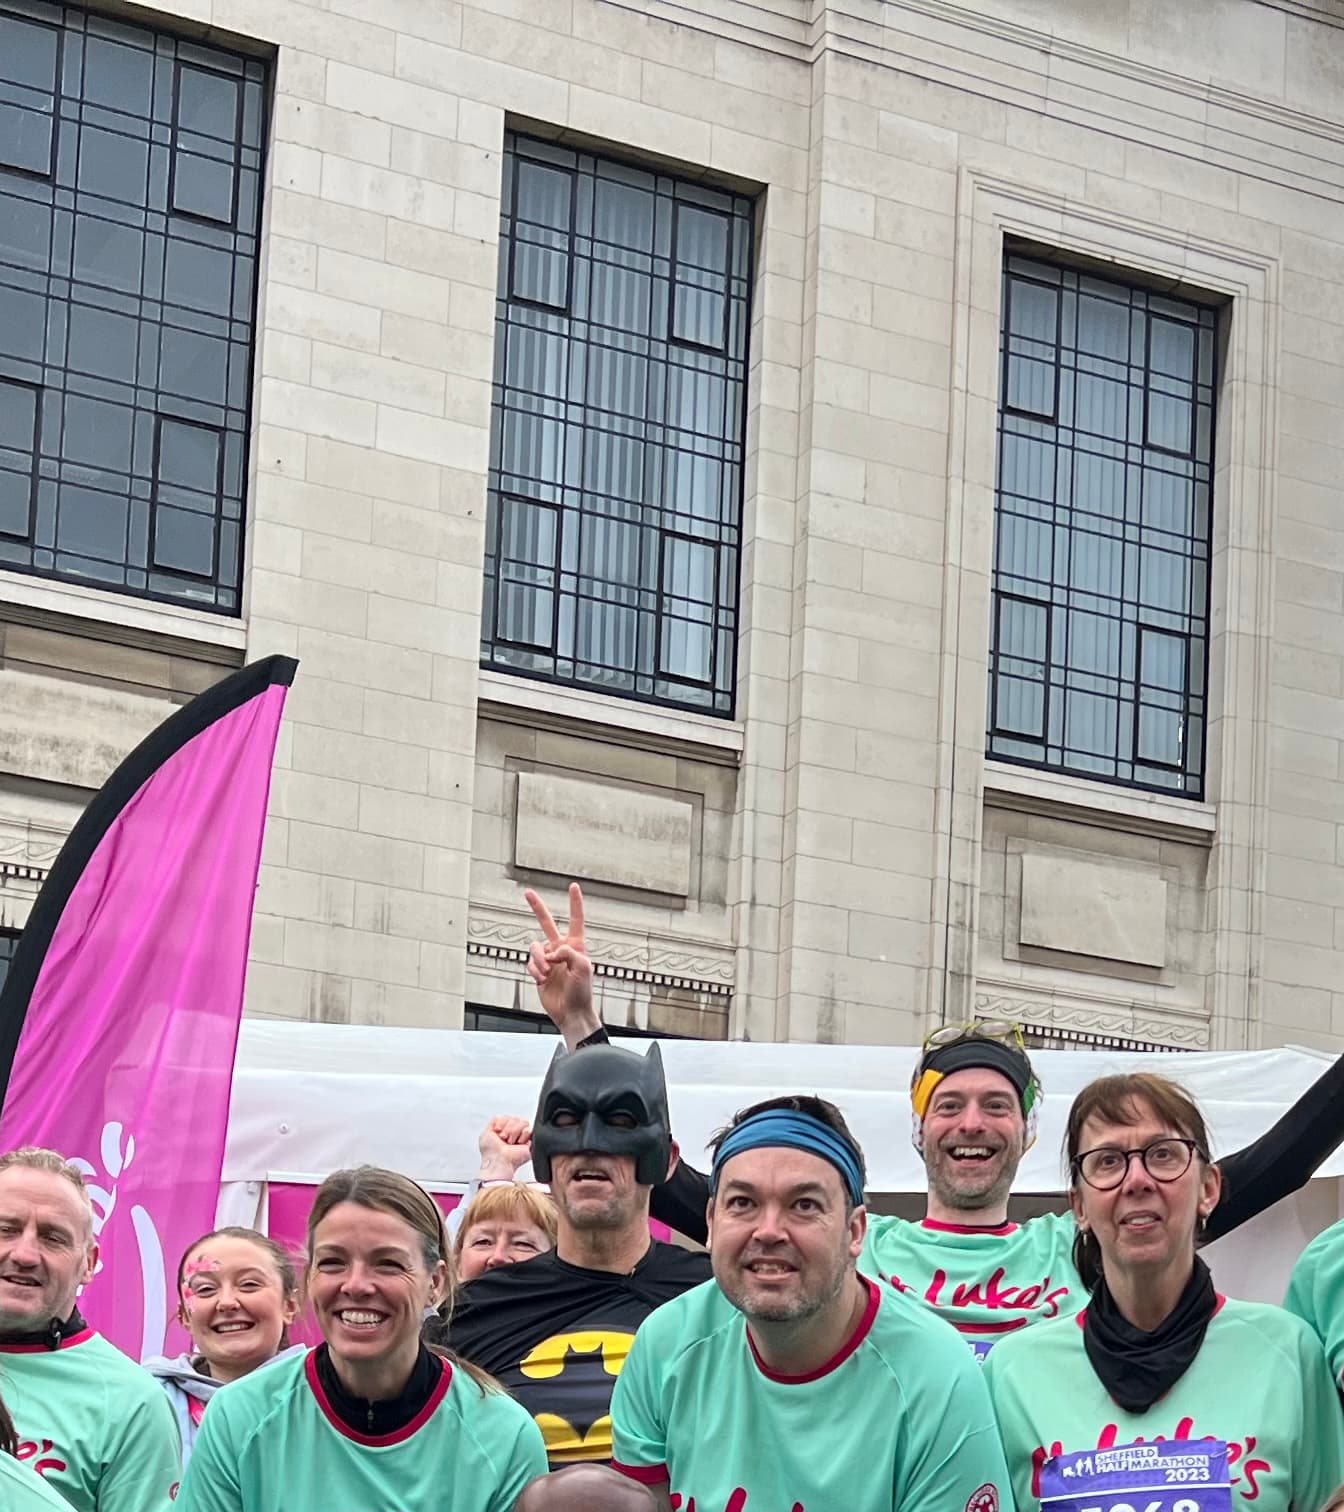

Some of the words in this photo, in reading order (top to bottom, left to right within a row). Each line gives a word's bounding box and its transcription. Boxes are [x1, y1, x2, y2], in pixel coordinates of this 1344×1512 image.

[1097, 1449, 1156, 1464] SHEFFIELD
[1096, 1460, 1127, 1473] HALF
[1131, 1457, 1207, 1470] MARATHON
[1165, 1468, 1210, 1482] 2023
